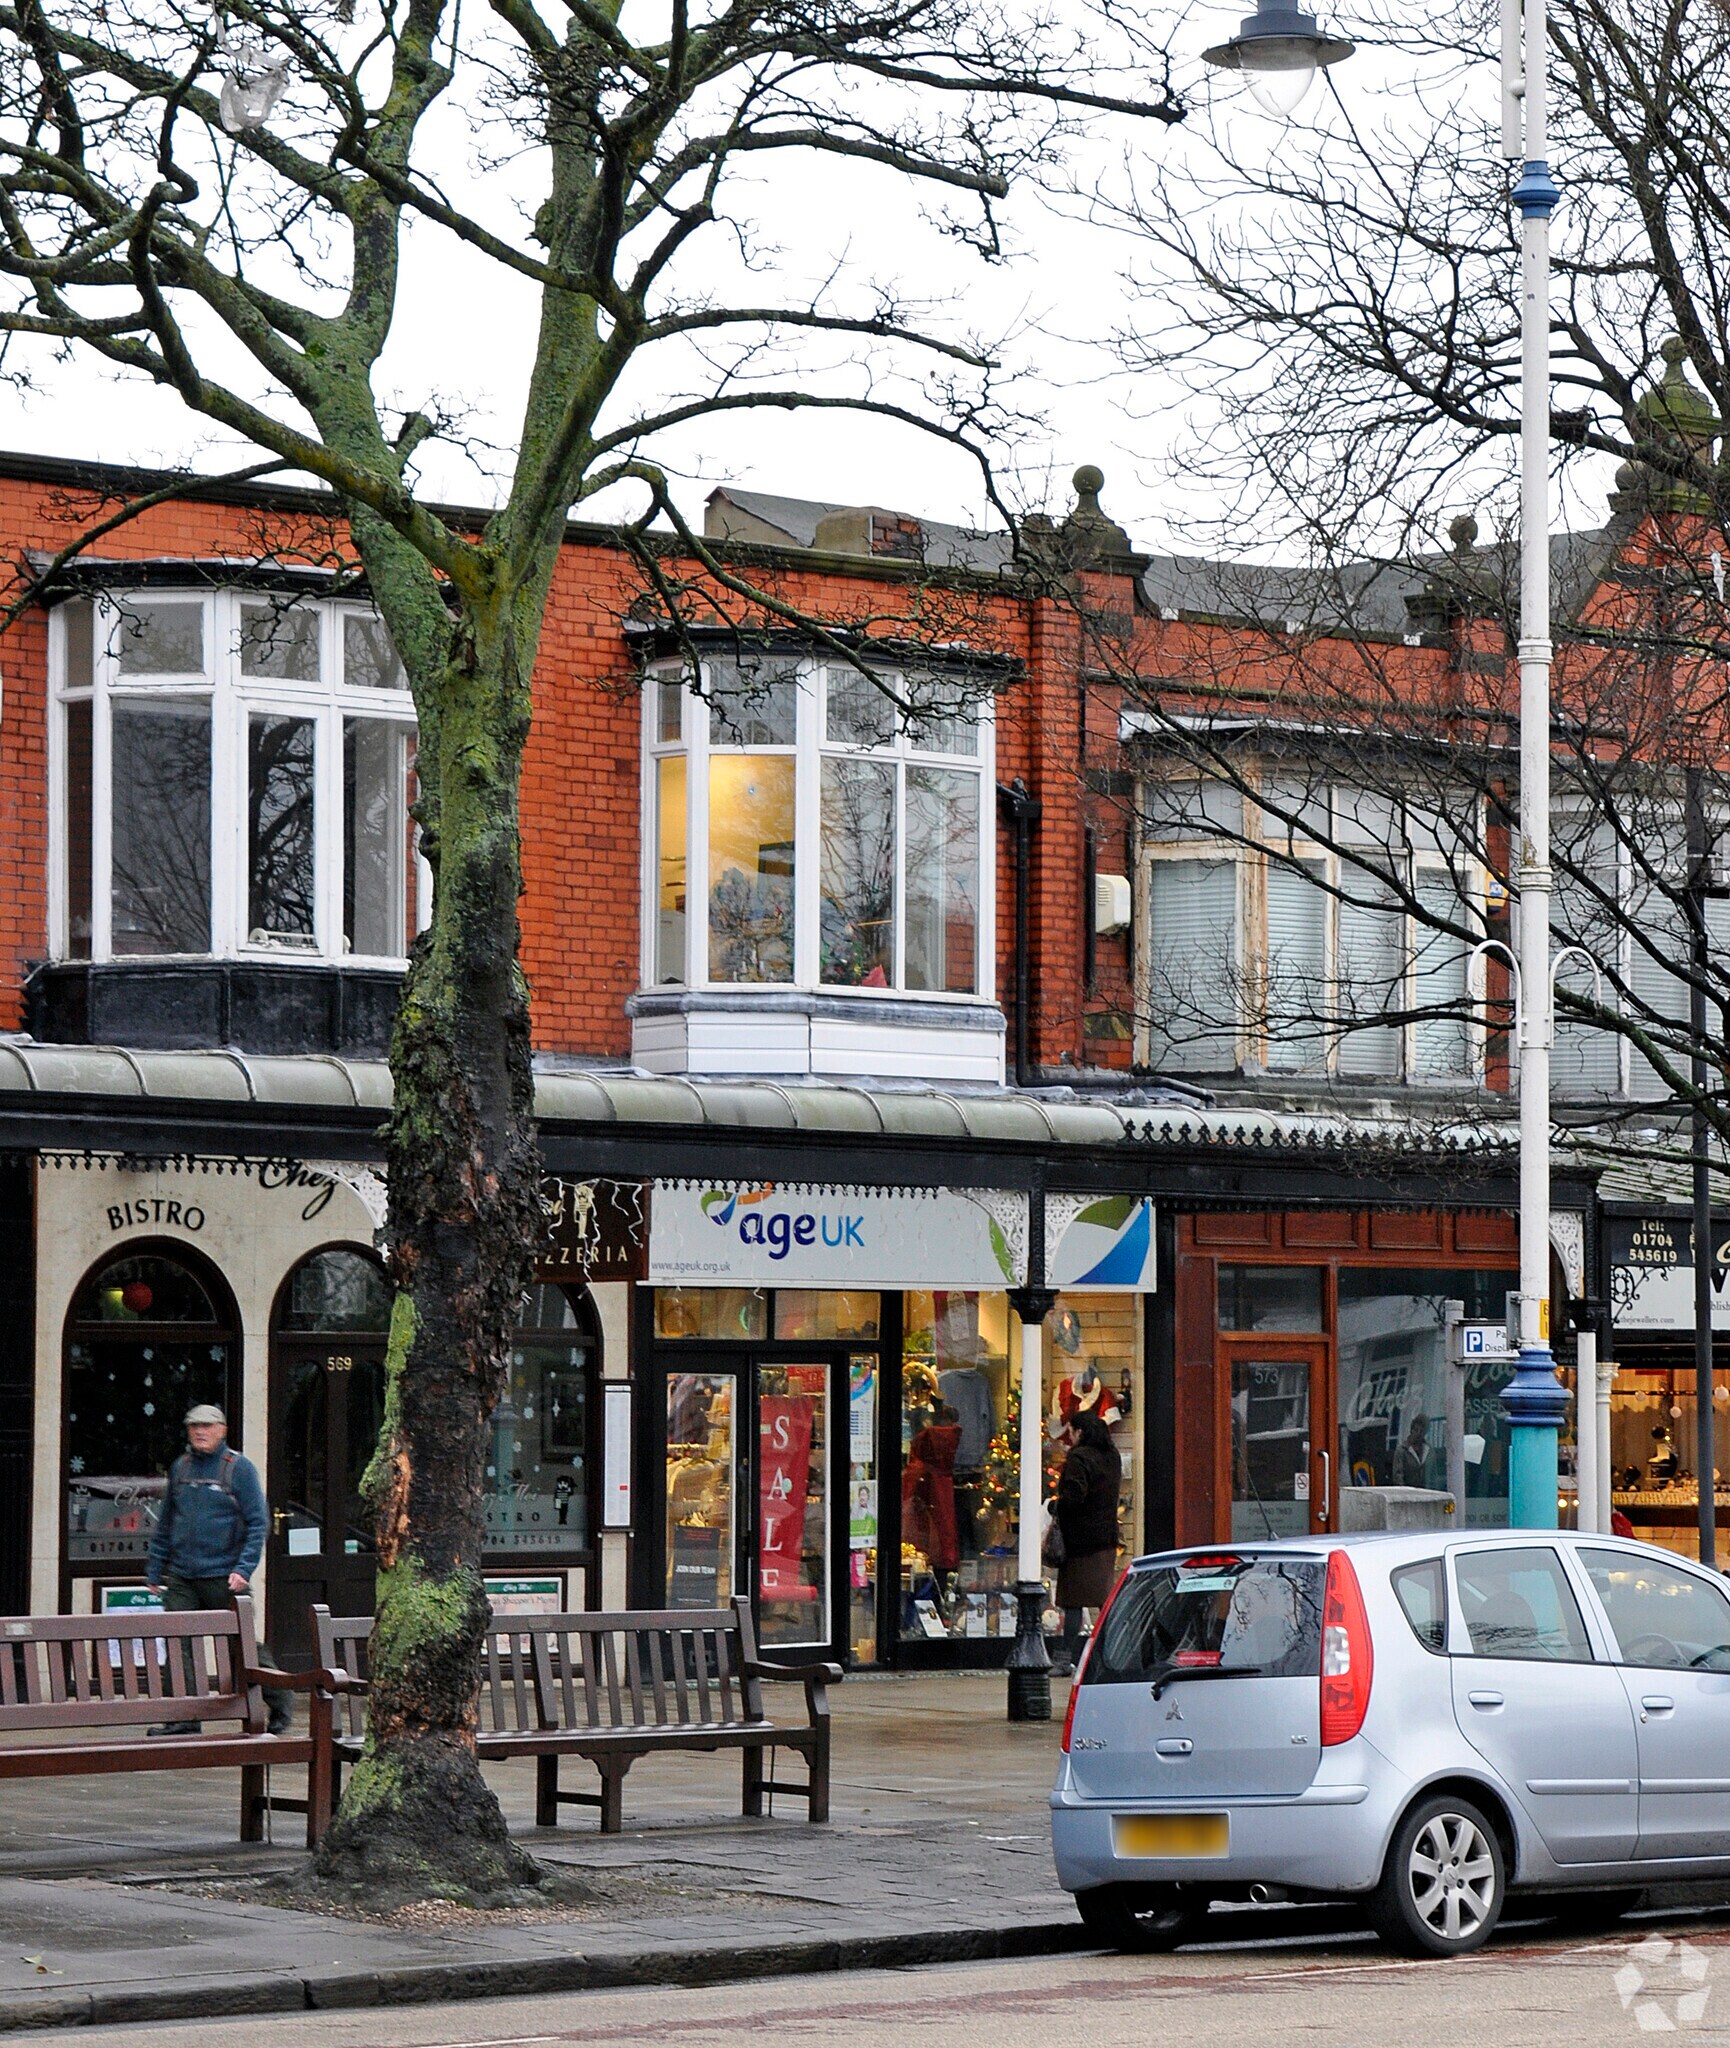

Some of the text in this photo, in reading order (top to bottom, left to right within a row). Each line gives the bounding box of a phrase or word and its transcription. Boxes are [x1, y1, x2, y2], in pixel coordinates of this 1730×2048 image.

[258, 1161, 338, 1221] Chez
[106, 1199, 206, 1231] BISTRO
[1641, 1220, 1665, 1232] Tel:
[739, 1213, 866, 1260] age UK
[1632, 1233, 1673, 1247] 01704
[534, 1246, 628, 1265] ZZERIA
[1628, 1248, 1678, 1262] 545619
[651, 1261, 731, 1273] www.ageuk.org.uk
[1496, 1330, 1507, 1338] Pa
[327, 1356, 352, 1371] 569
[1254, 1367, 1279, 1384] 573
[761, 1415, 790, 1587] SALE
[113, 1517, 151, 1528] BIS
[486, 1512, 540, 1522] STRO
[482, 1535, 505, 1546] 704
